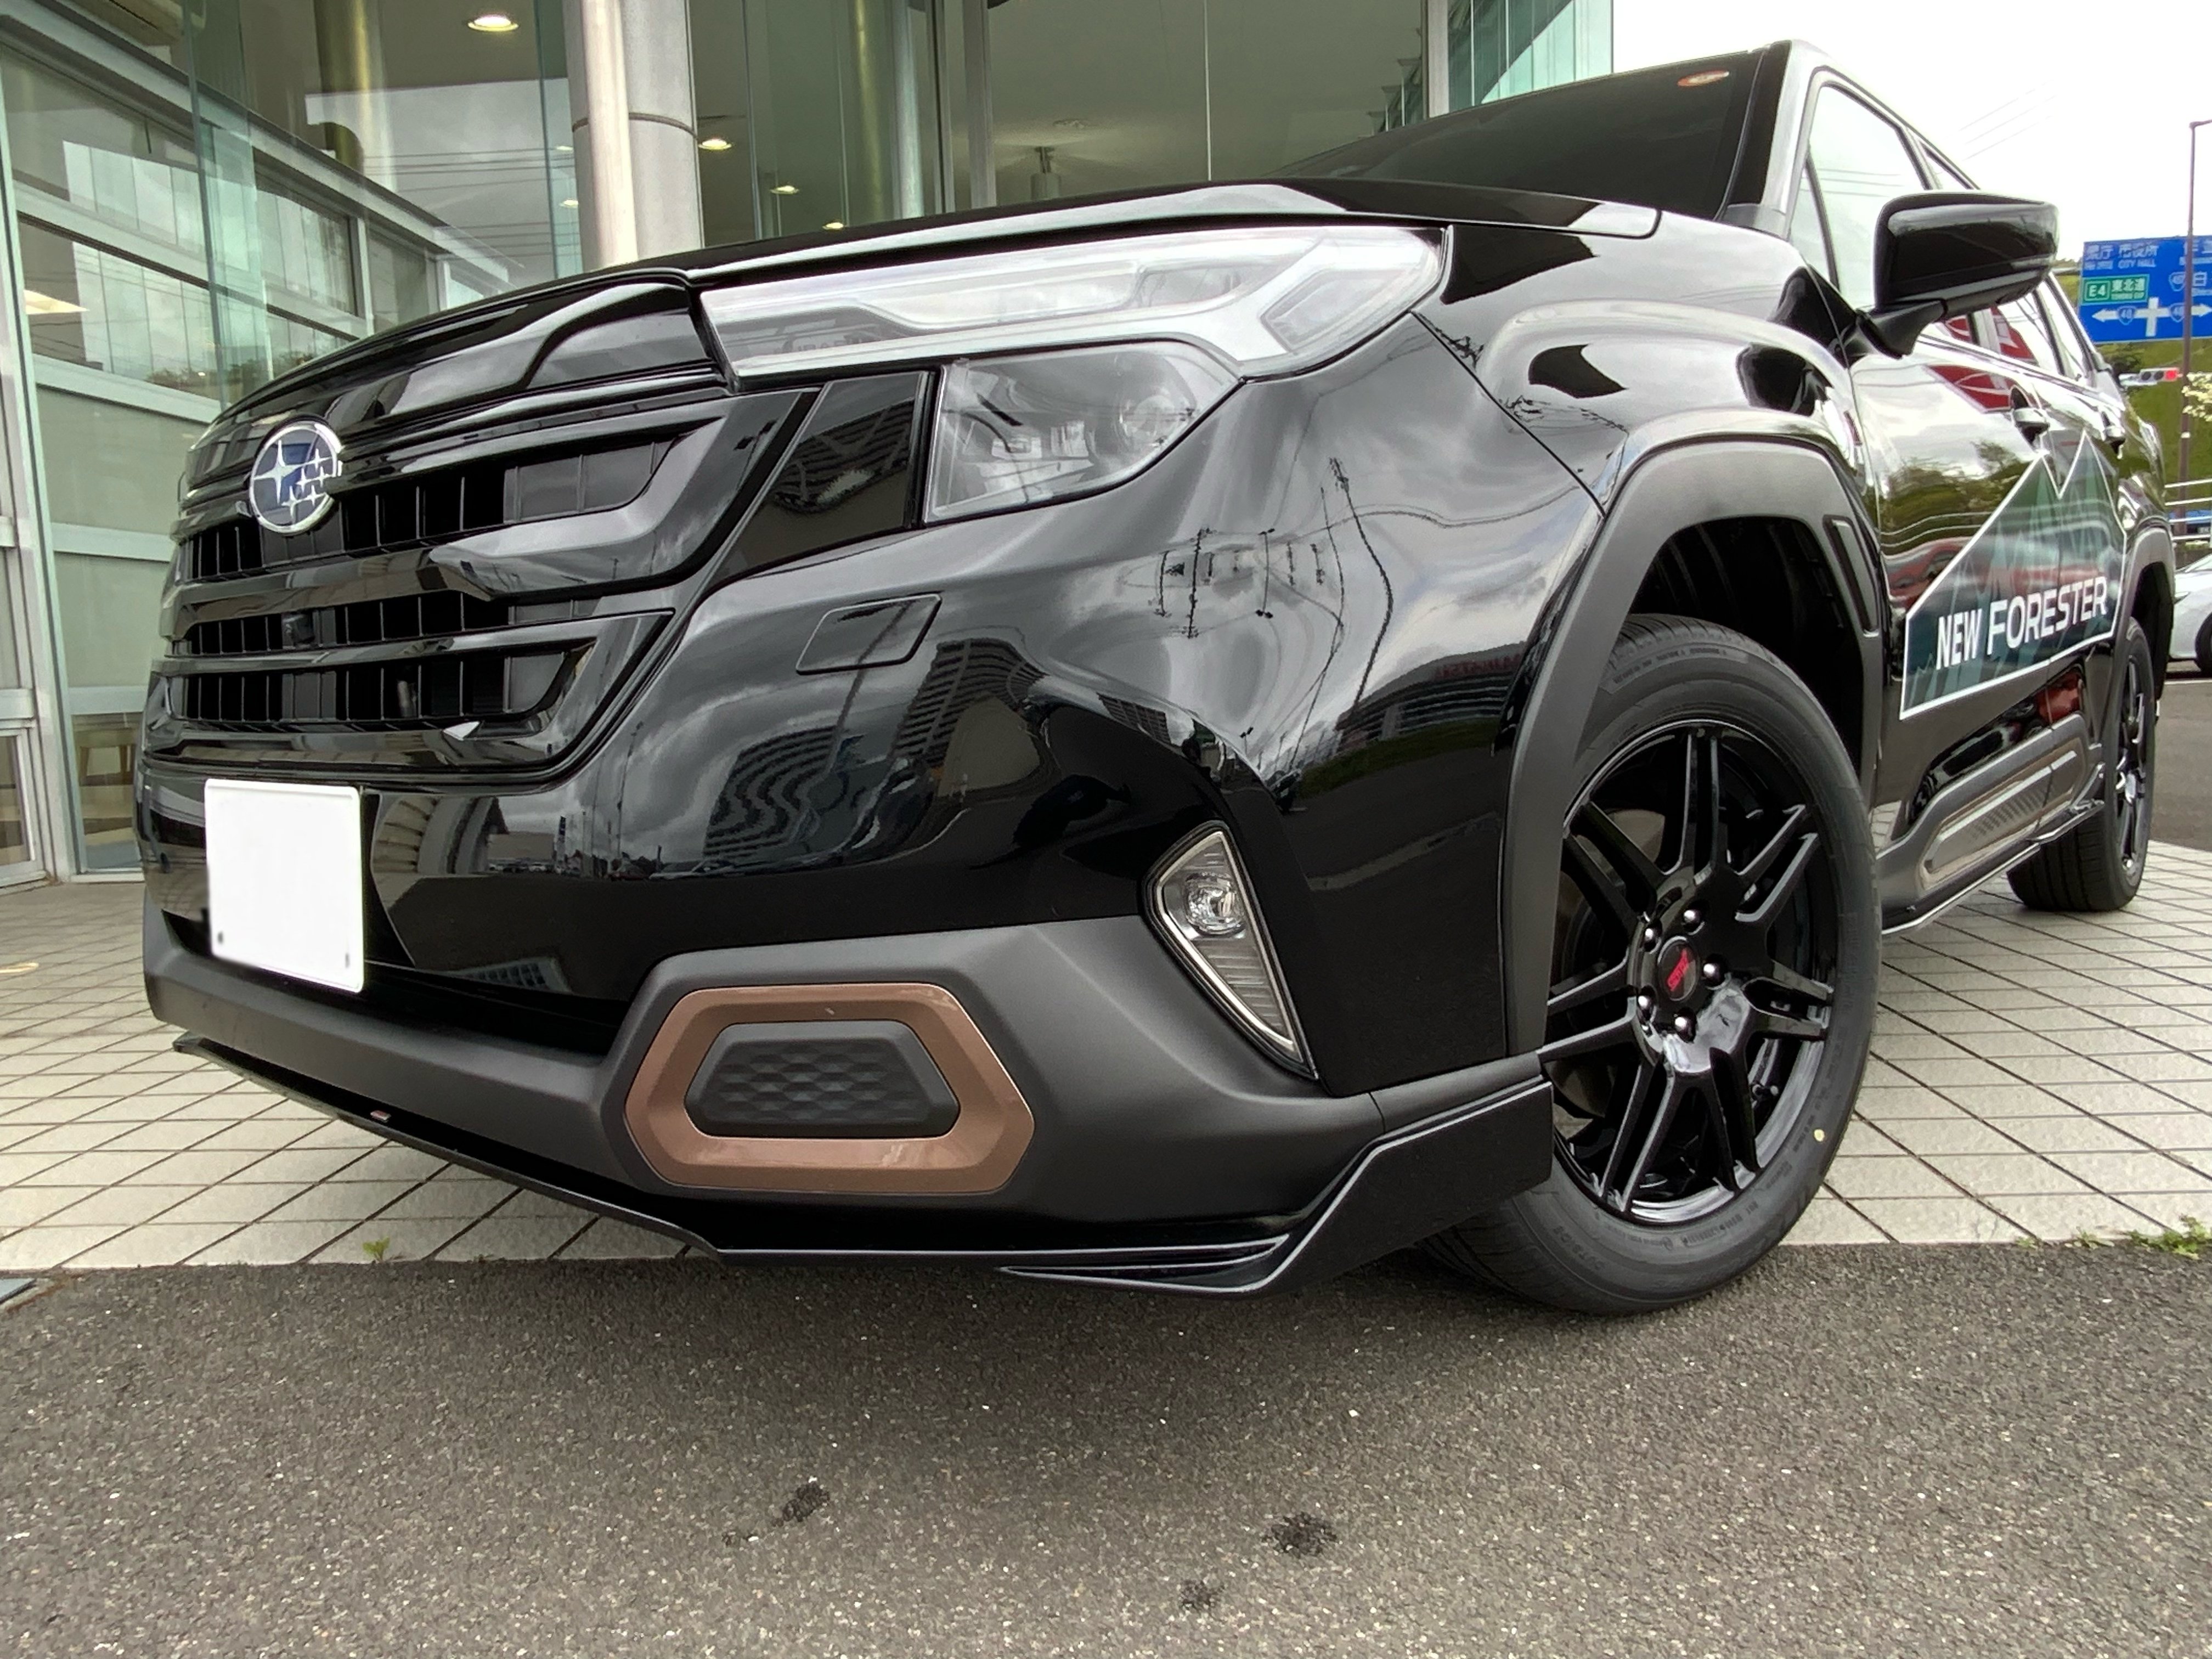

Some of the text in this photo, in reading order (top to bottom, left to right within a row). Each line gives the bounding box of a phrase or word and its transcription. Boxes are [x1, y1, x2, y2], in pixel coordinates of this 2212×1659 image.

[2089, 284, 2106, 297] E4
[1936, 576, 2108, 670] NEW FORESTER
